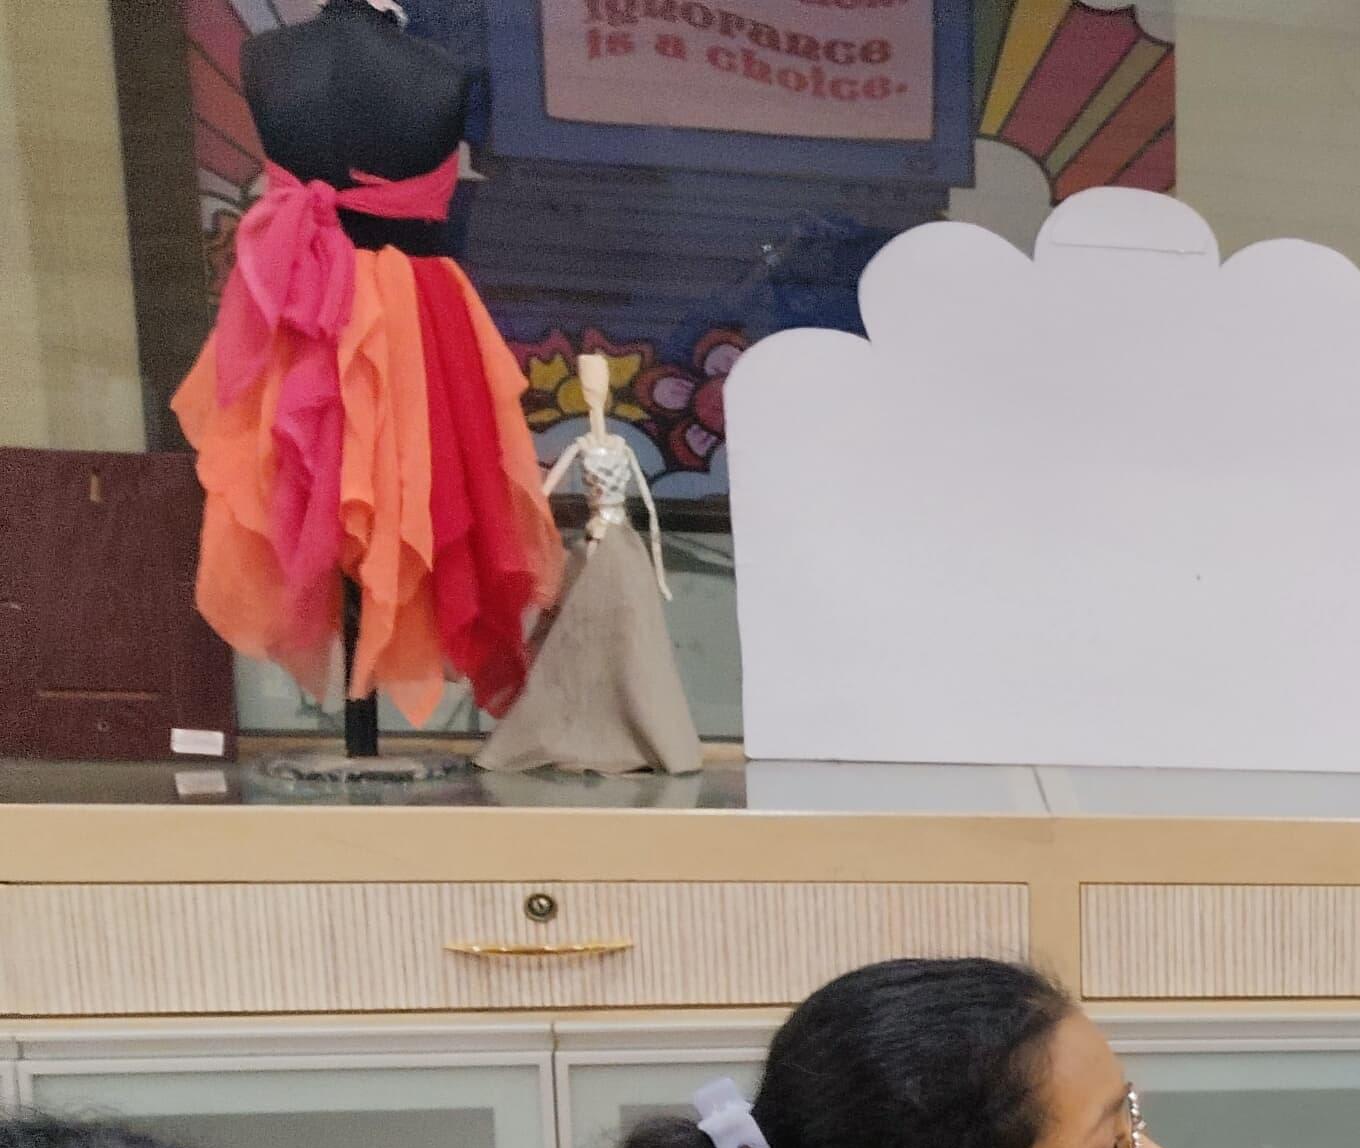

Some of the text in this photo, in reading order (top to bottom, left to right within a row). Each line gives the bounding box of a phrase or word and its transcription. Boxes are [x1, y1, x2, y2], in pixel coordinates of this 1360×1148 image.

[585, 0, 892, 64] ignorance
[586, 28, 908, 101] is a choice.
